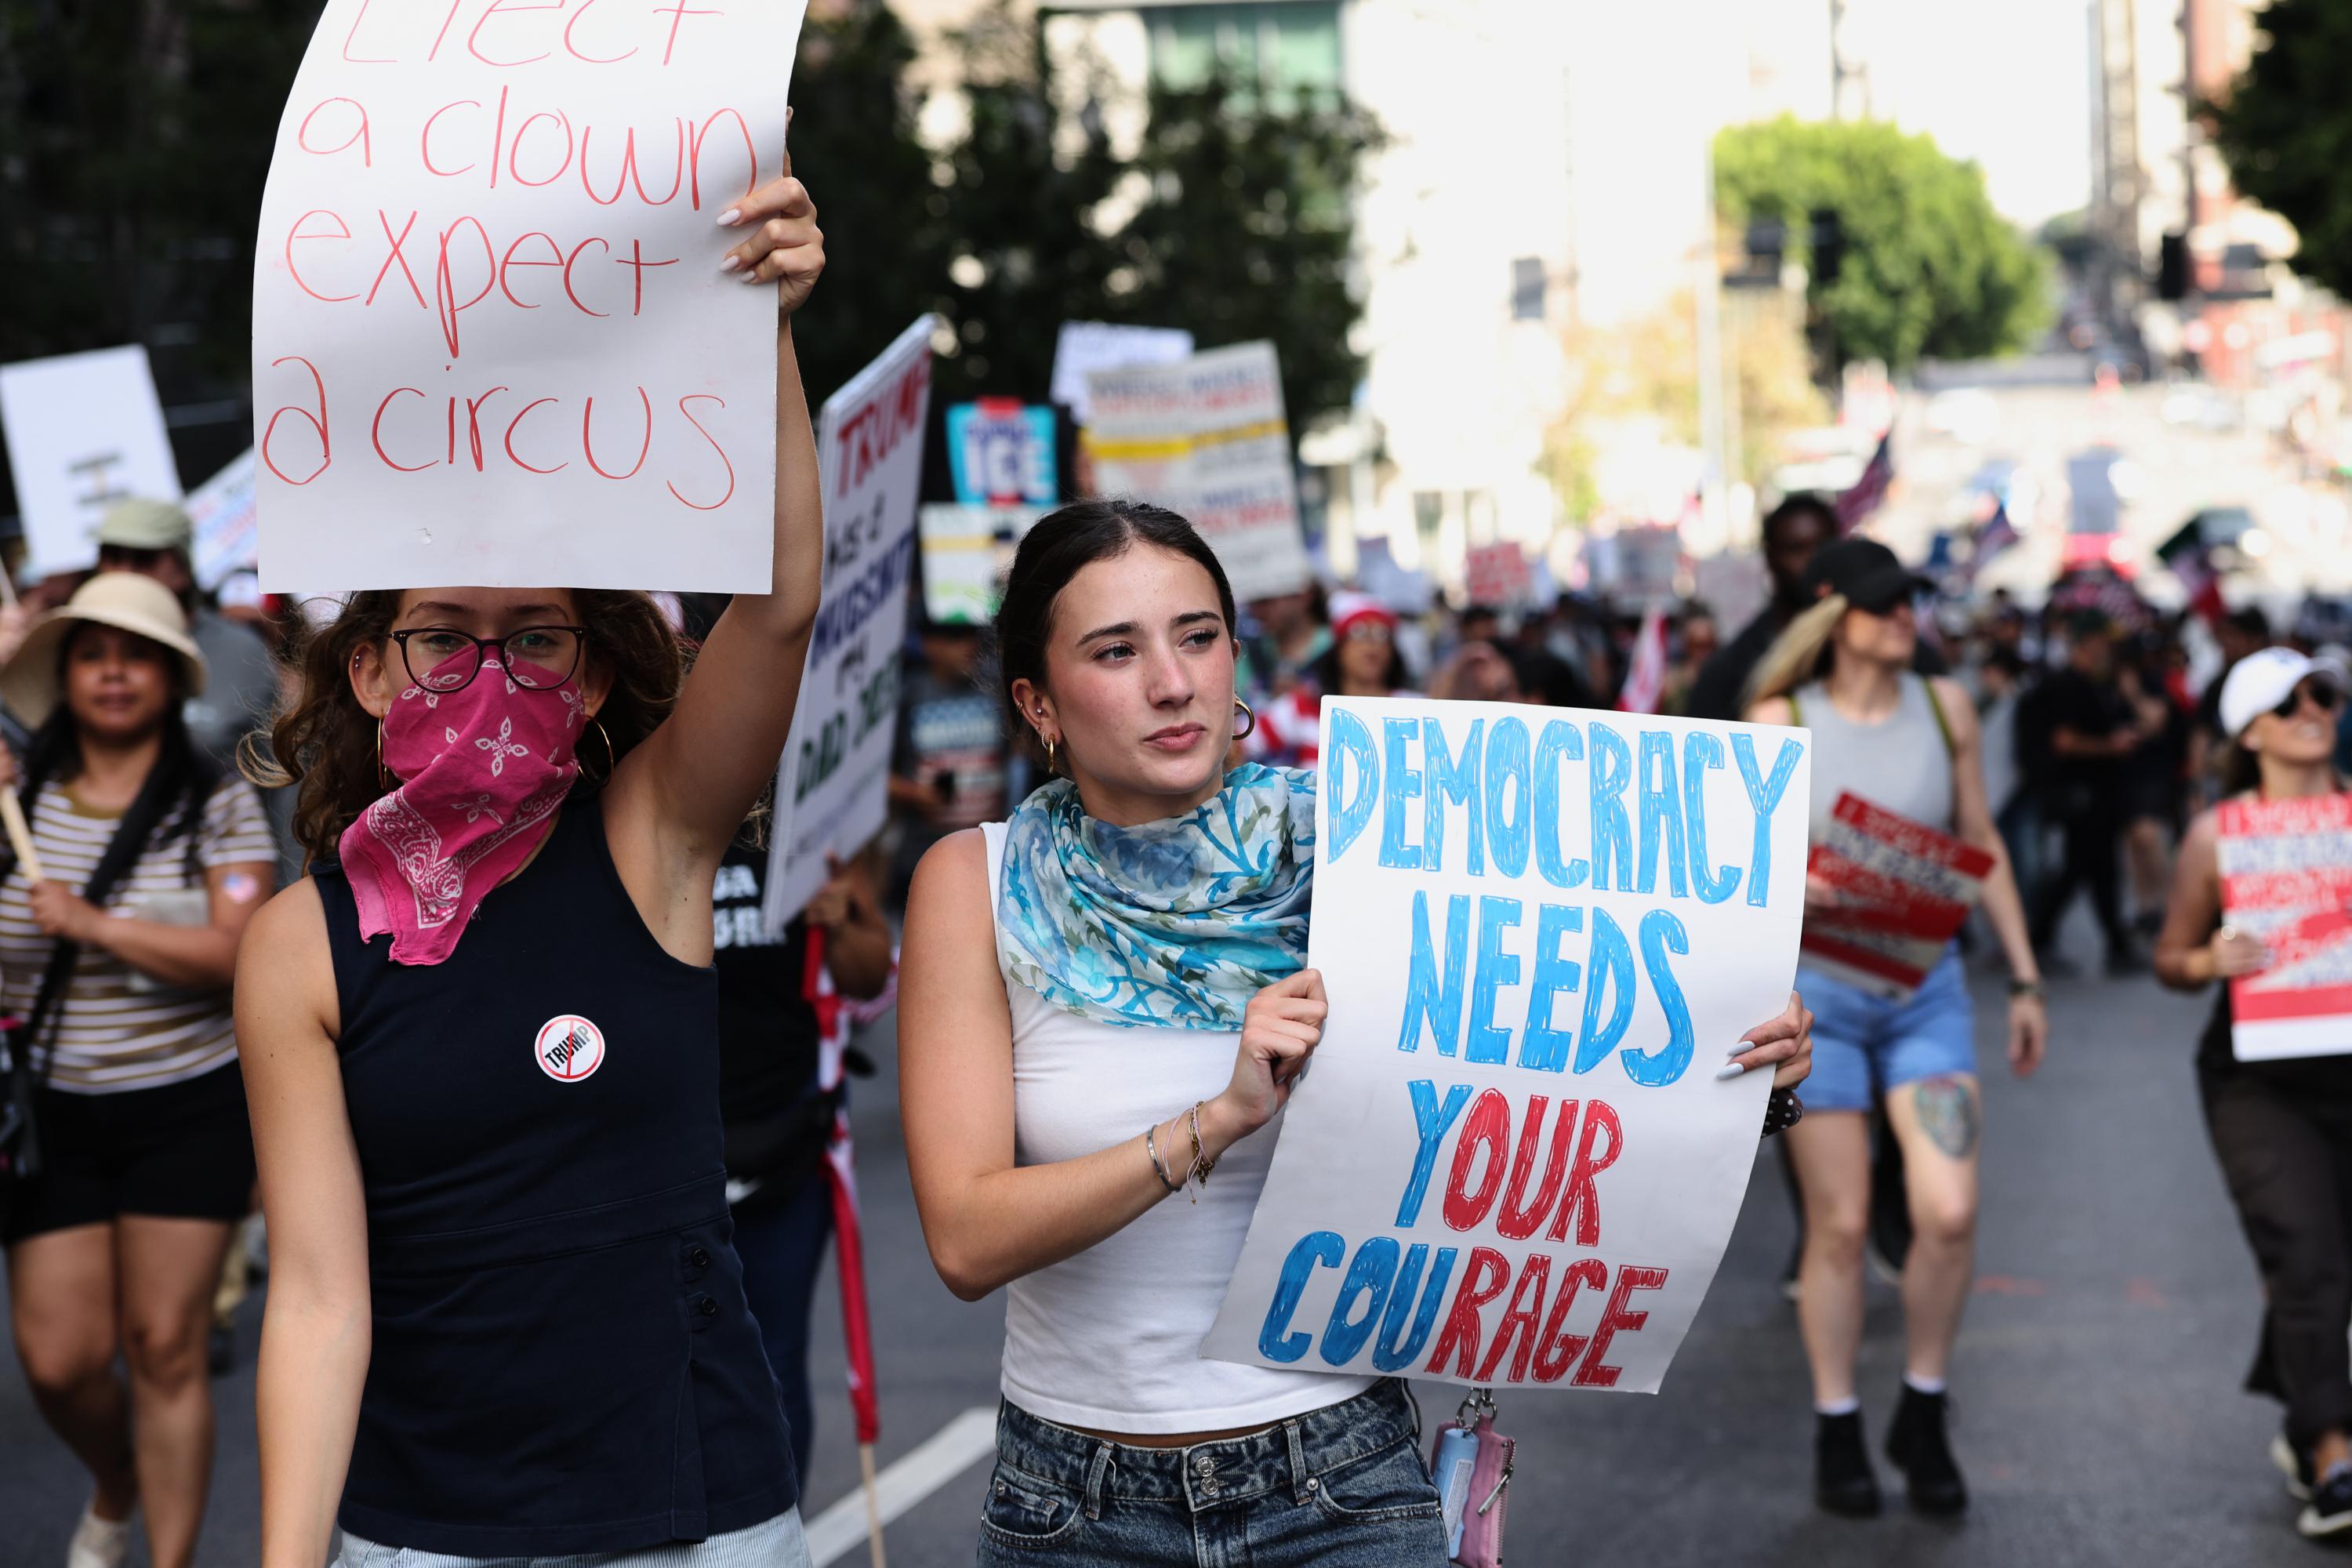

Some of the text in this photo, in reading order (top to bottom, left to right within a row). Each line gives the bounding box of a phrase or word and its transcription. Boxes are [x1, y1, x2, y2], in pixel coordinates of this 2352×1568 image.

[299, 85, 757, 212] a clown
[285, 209, 680, 358] expect
[262, 356, 735, 510] a circus
[1327, 707, 1804, 908] DEMOCRACY
[545, 1025, 590, 1069] TRUMP
[1396, 889, 1696, 1087] NEEDS
[1394, 1079, 1623, 1247] YOUR
[1258, 1231, 1669, 1386] COURAGE
